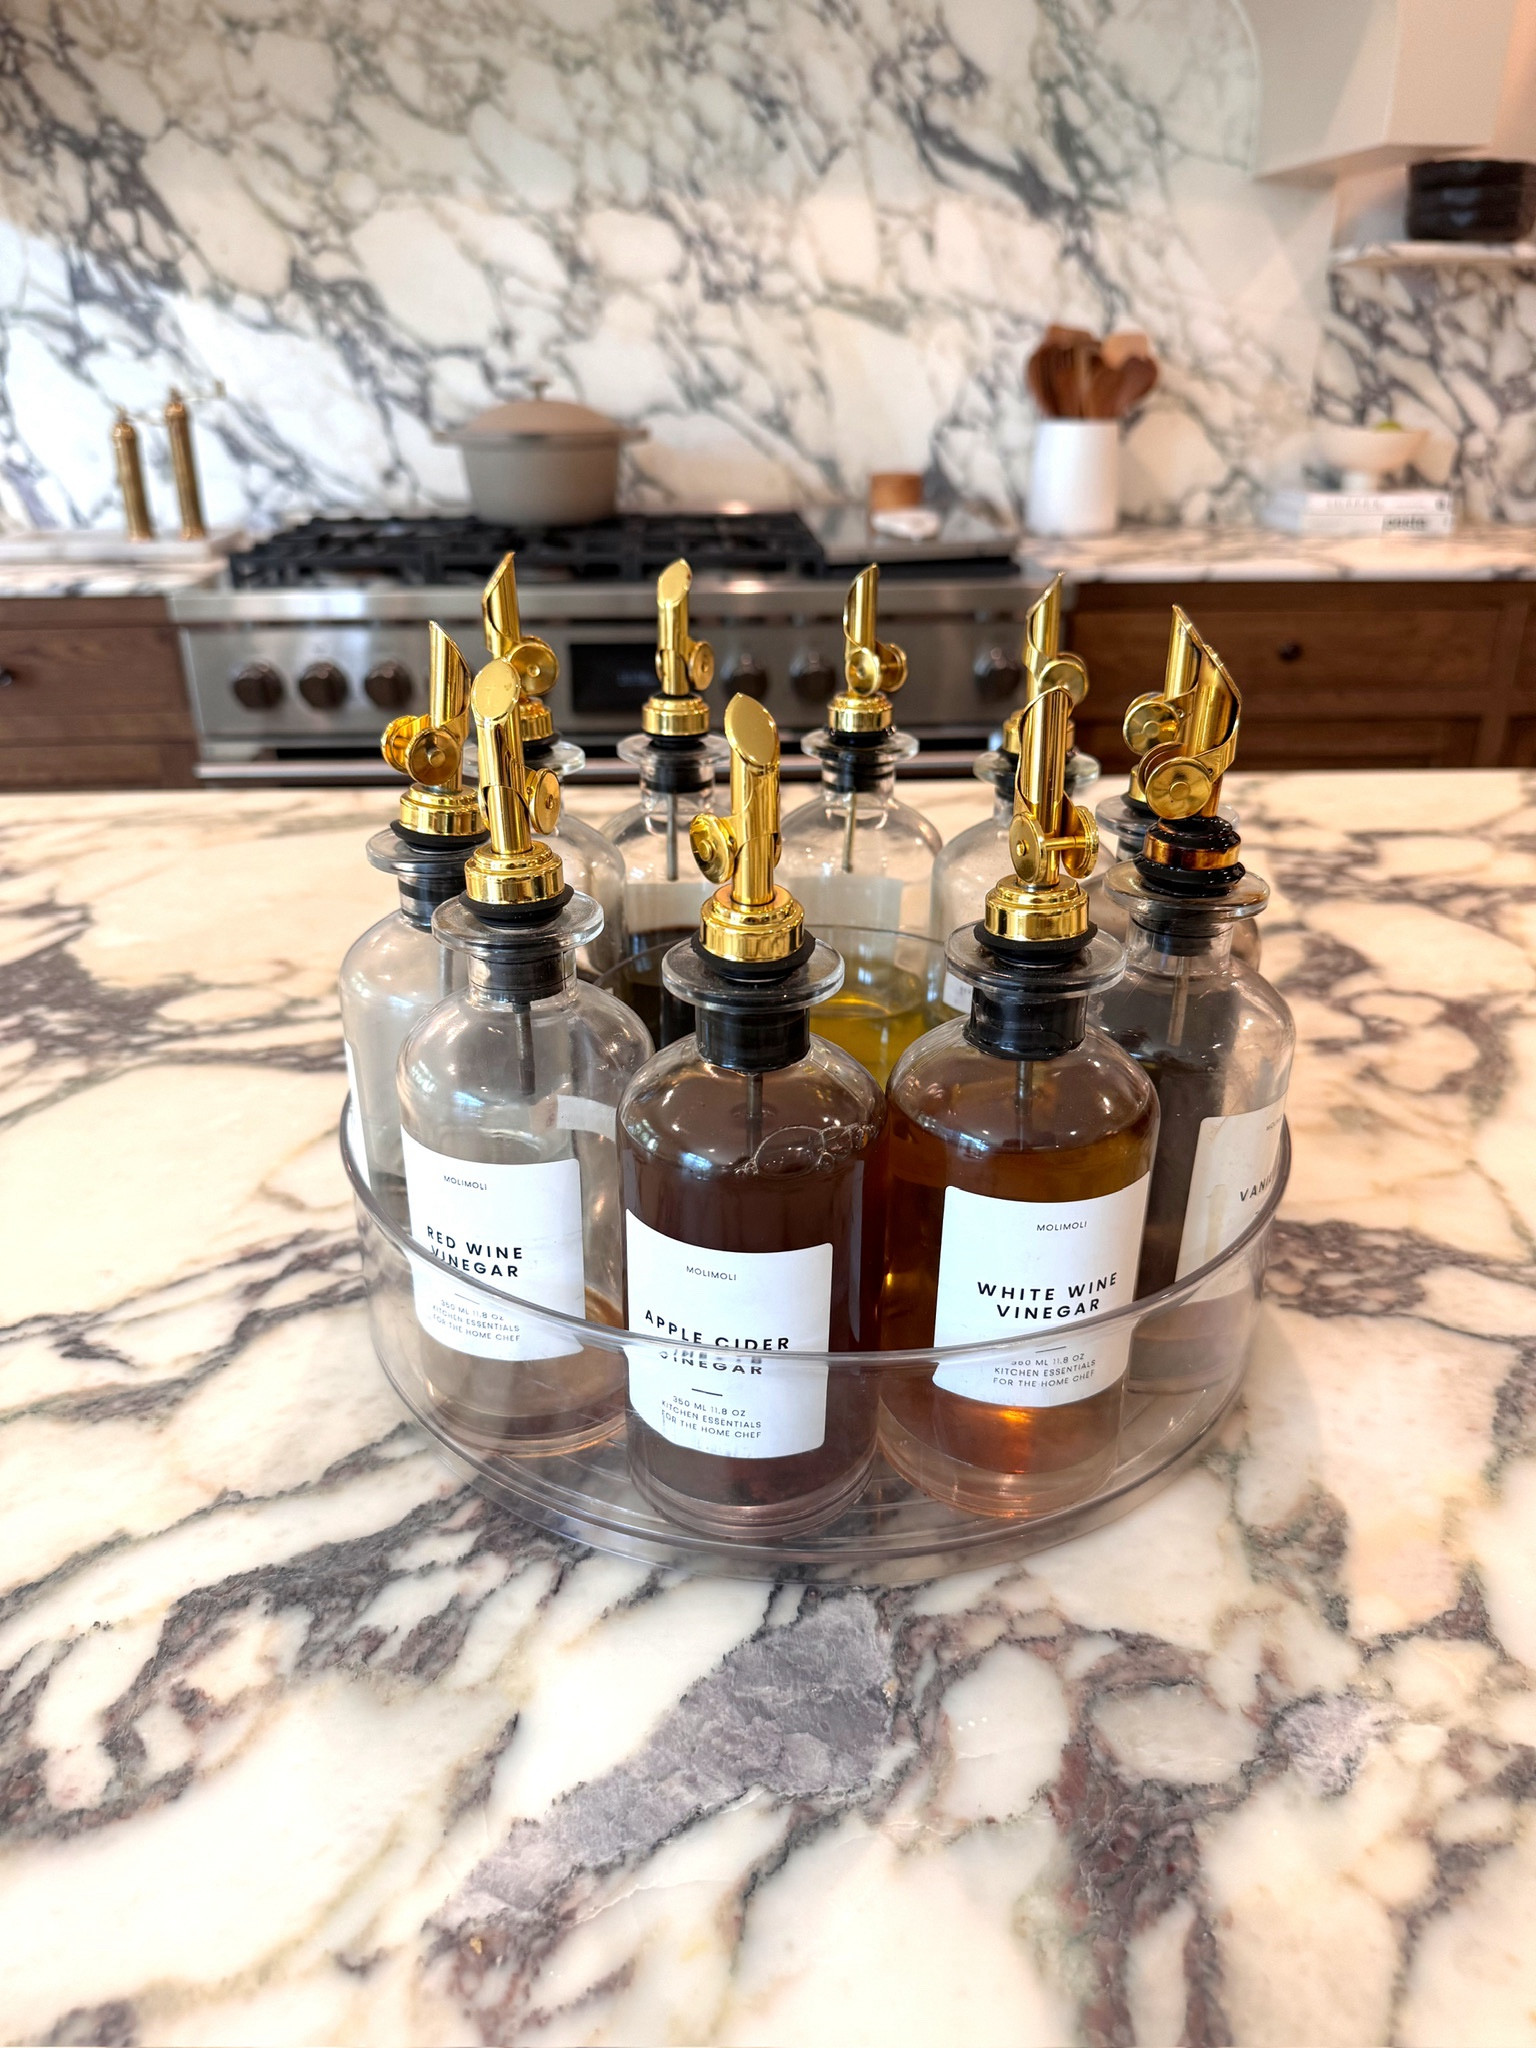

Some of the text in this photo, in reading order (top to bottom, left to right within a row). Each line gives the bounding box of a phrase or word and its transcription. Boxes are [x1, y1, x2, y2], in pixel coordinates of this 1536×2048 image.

[443, 1174, 488, 1191] MOLIMOLI
[1036, 1221, 1087, 1231] MOLIMOLI
[427, 1226, 523, 1260] RED WINE
[431, 1245, 519, 1277] VINEGAR
[686, 1265, 738, 1281] MOLIMOLI
[977, 1272, 1117, 1301] WHITE WINE
[432, 1304, 521, 1332] KITCHEN ESSENTIALS
[458, 1306, 470, 1316] ML
[472, 1310, 488, 1319] 11.8
[997, 1298, 1100, 1319] VINEGAR
[433, 1313, 521, 1342] FOR THE HOME CHEF
[645, 1309, 790, 1351] APPLE CIDER
[994, 1359, 1096, 1377] KITCHEN ESSENTIALS
[1053, 1356, 1068, 1365] 11.8
[1072, 1353, 1085, 1361] OZ
[993, 1369, 1095, 1388] FOR THE HOME CHEF
[662, 1400, 762, 1428] KITCHEN ESSENTIALS
[694, 1402, 707, 1412] ML
[711, 1406, 728, 1416] 11.8
[732, 1409, 746, 1417] OZ
[661, 1409, 762, 1439] FOR THE HOME CHEF
